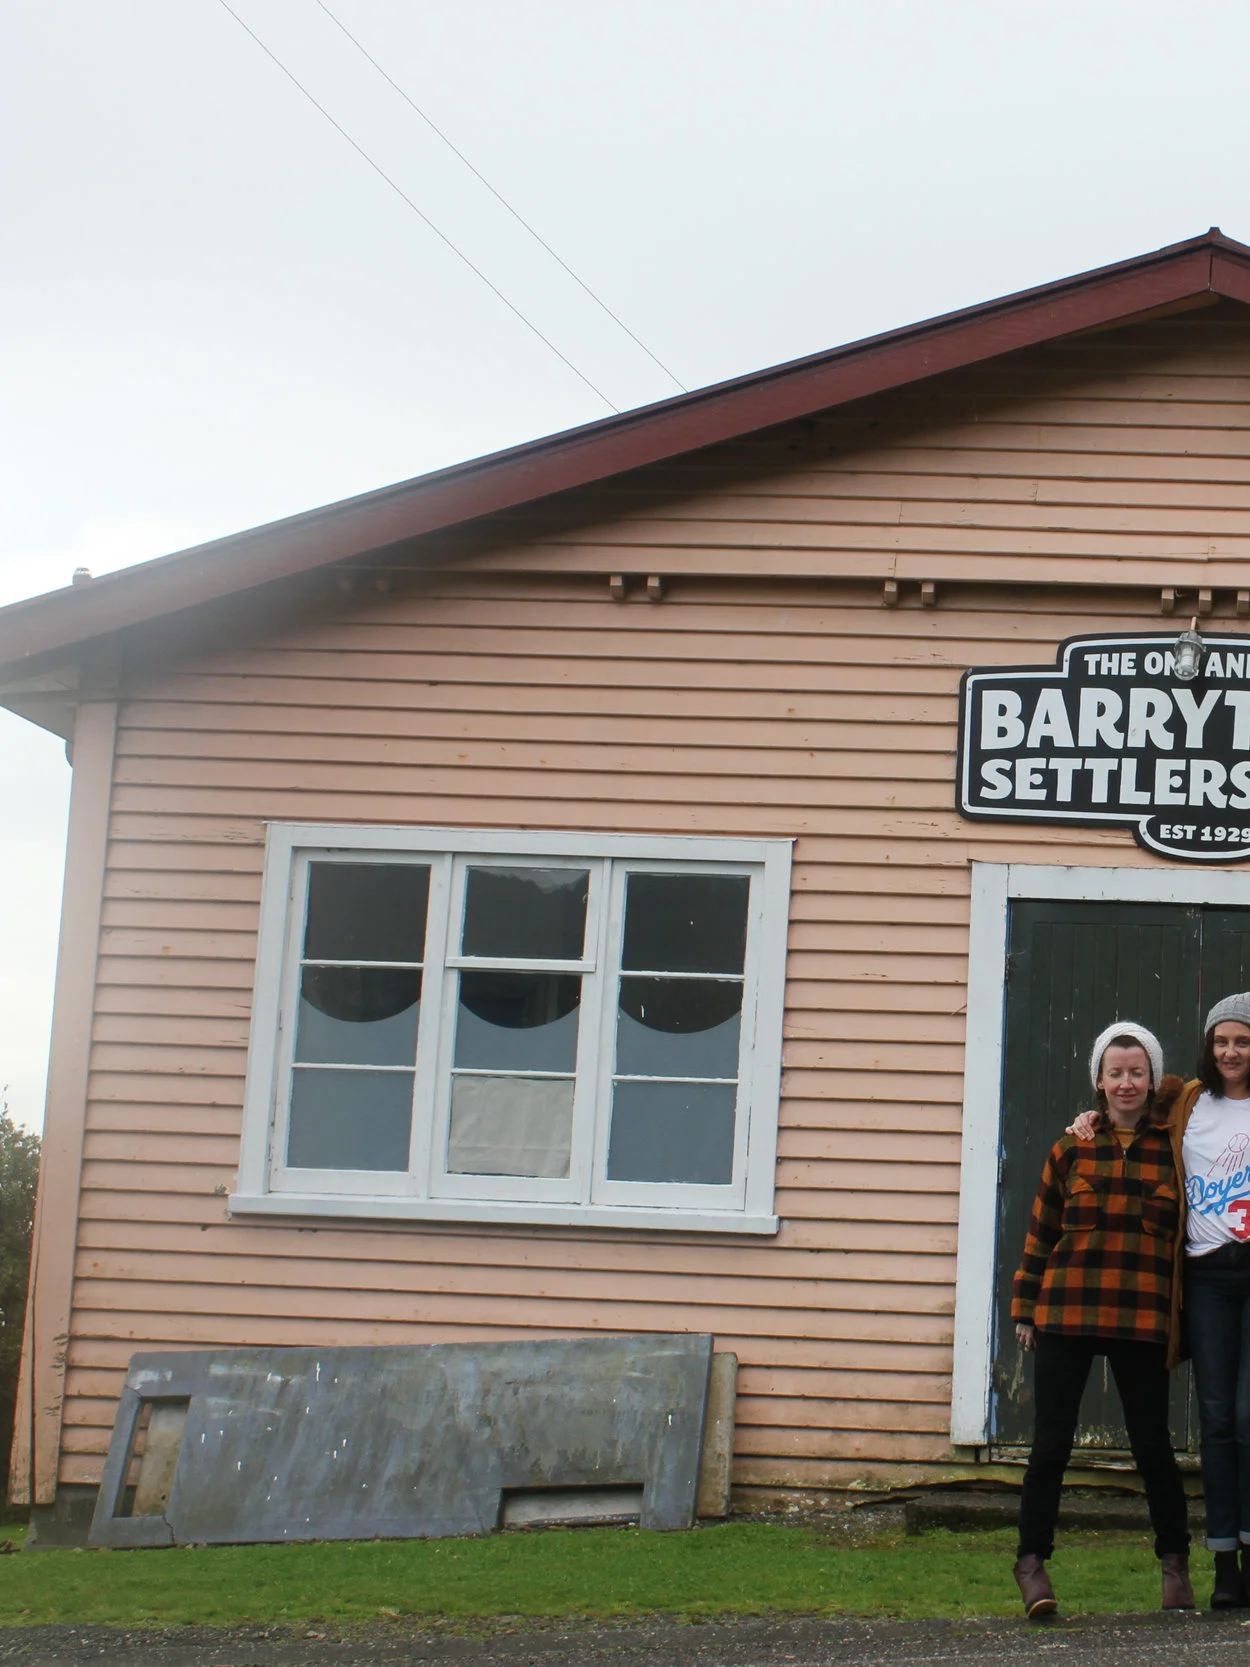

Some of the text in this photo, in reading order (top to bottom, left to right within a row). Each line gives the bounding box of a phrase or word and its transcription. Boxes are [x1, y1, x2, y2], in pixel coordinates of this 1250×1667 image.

[1084, 652, 1137, 676] THE
[1144, 651, 1199, 677] ON
[1160, 824, 1197, 840] EST
